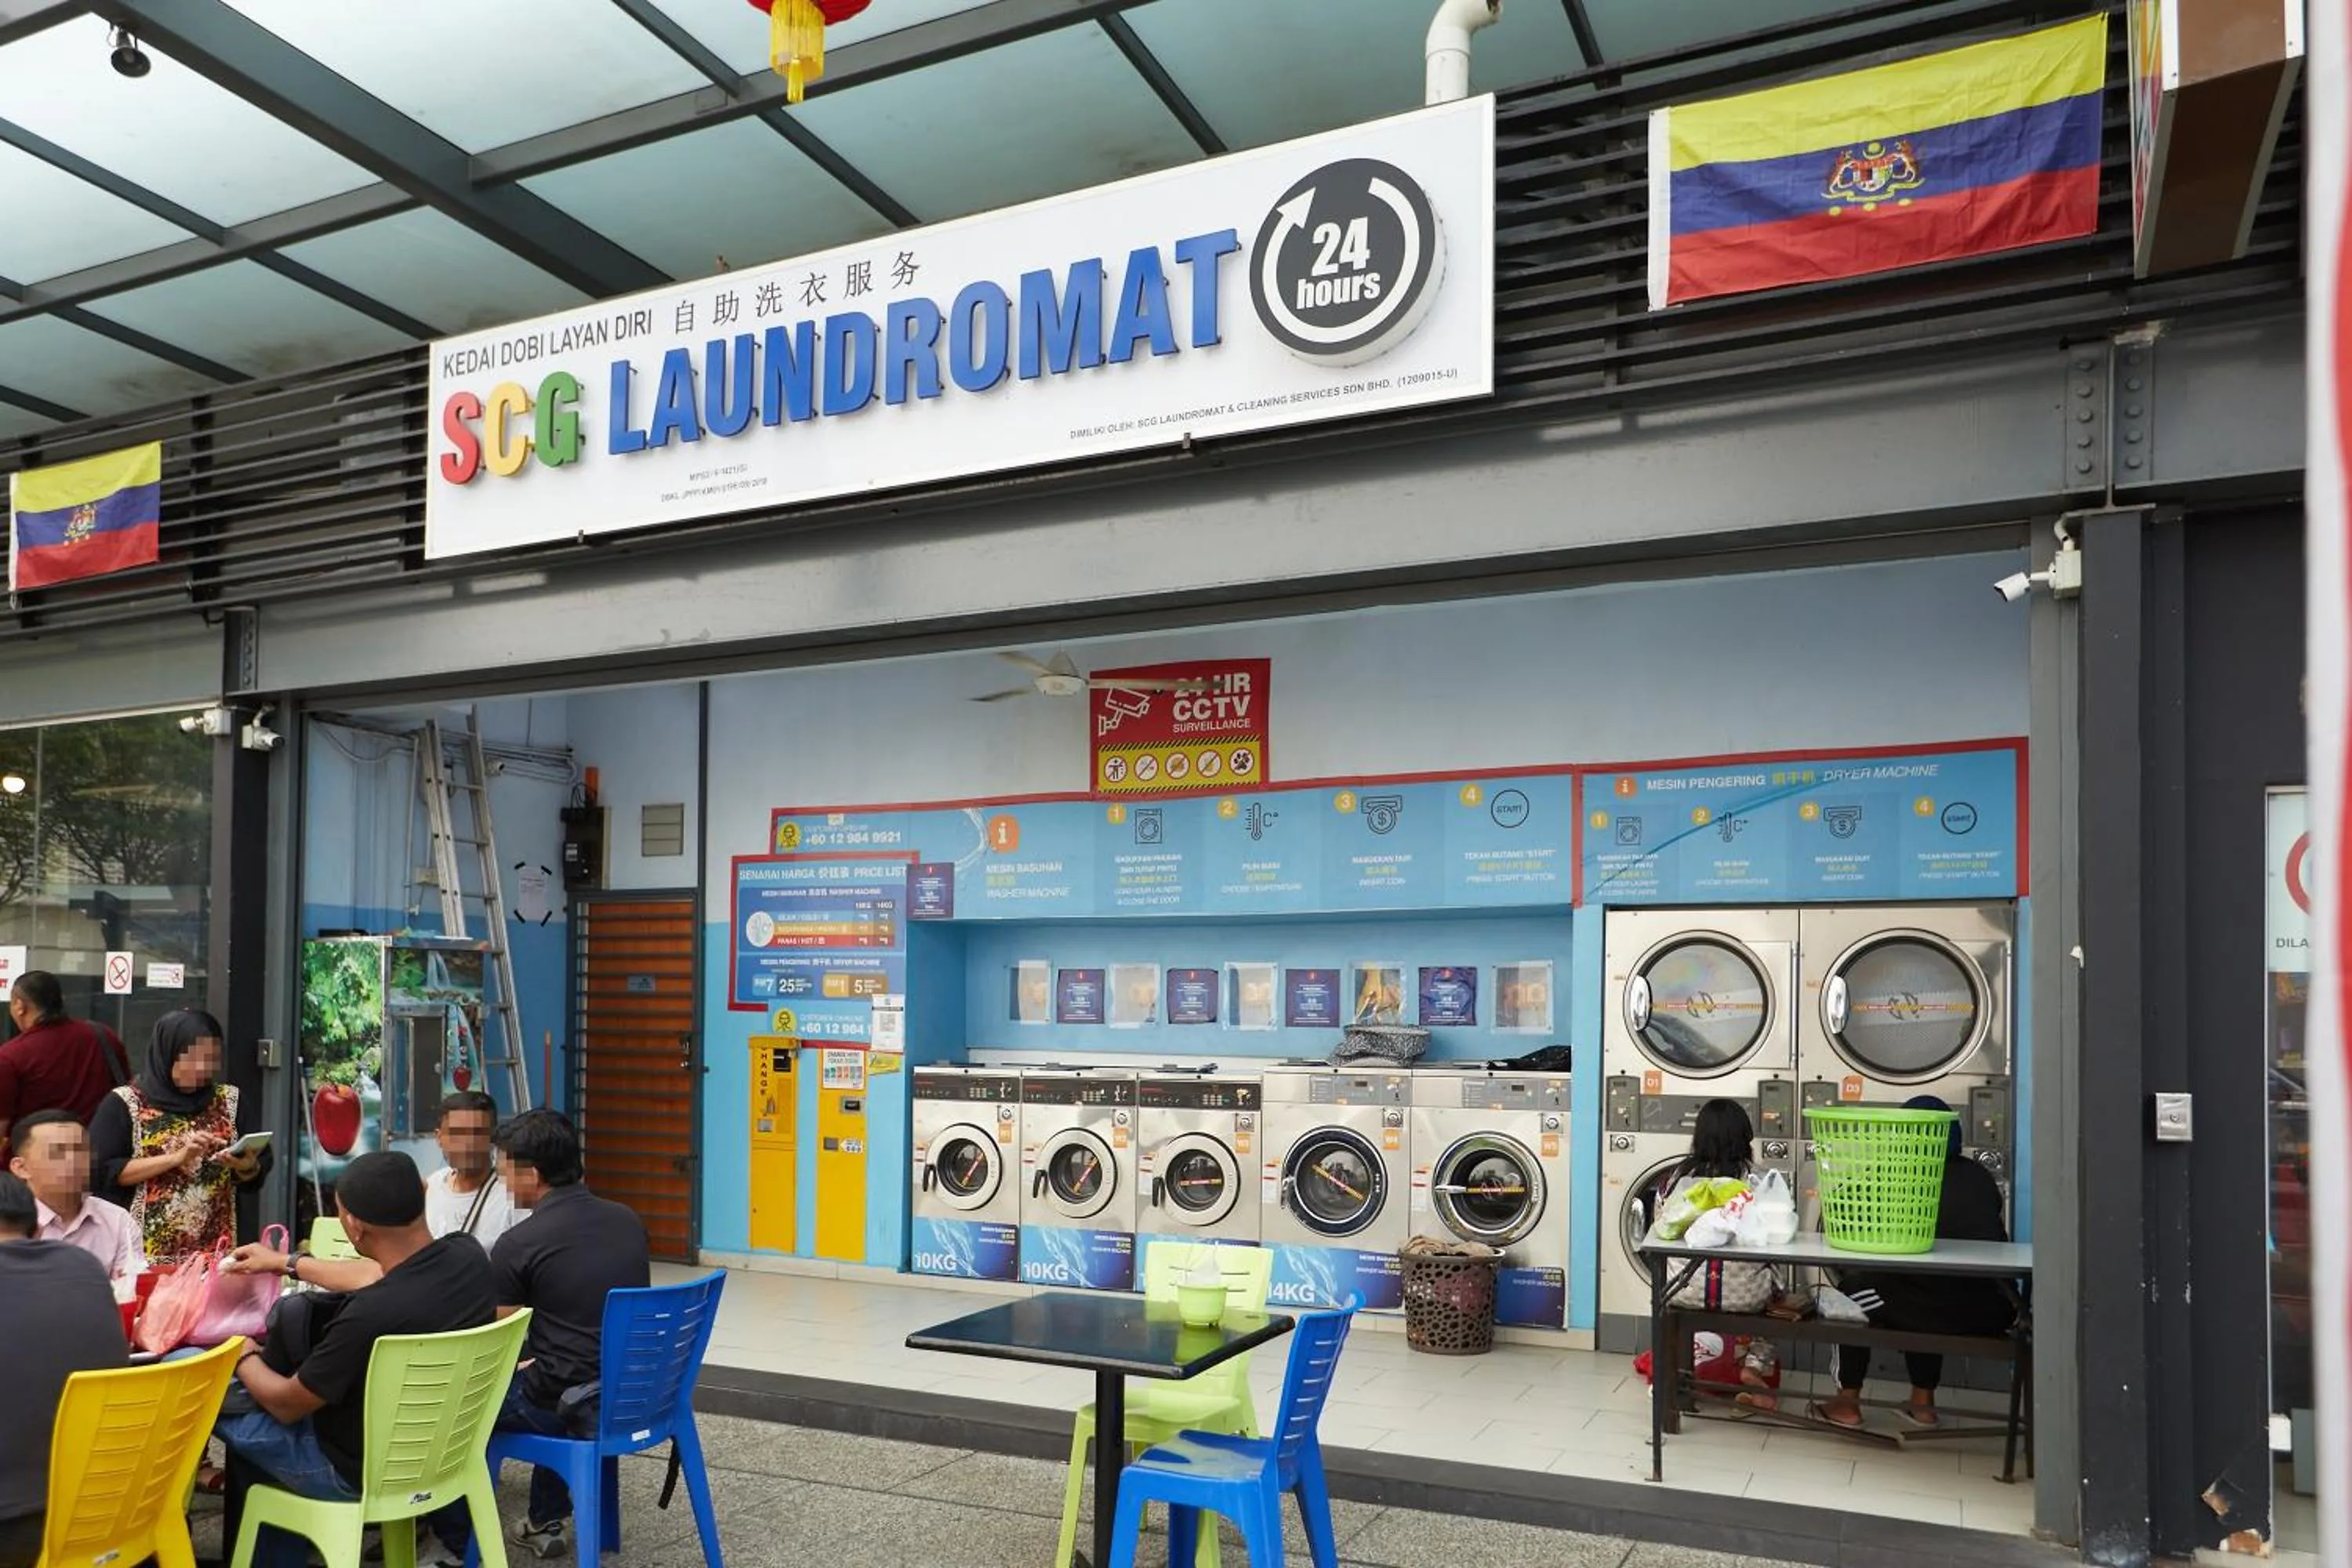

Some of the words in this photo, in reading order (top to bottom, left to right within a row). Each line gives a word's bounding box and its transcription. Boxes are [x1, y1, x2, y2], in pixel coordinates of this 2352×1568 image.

[1311, 217, 1370, 277] 24
[675, 251, 920, 335] 自助洗衣服务
[1296, 270, 1381, 310] hours
[443, 344, 495, 379] KEDAI
[501, 334, 543, 366] DOBI
[550, 318, 608, 354] LAYAN
[615, 309, 652, 340] DIRI
[441, 371, 581, 485] SCG
[608, 227, 1237, 456] LAUNDROMAT
[1160, 405, 1225, 424] LAUNDROMAT
[1228, 405, 1234, 413] &
[1237, 395, 1287, 412] CLEANING
[1290, 387, 1340, 403] SERVICES
[1343, 382, 1365, 394] SDN
[1213, 672, 1251, 695] HR
[1173, 695, 1251, 721] CCTV
[1173, 717, 1251, 734] SURVEILLANCE
[1646, 778, 1686, 790] MESIN
[1690, 774, 1766, 789] PENGERING
[1822, 767, 1871, 782] DRYER
[1873, 764, 1941, 779] MACHINE
[1341, 796, 1351, 808] 3
[1466, 789, 1475, 801] 4
[1496, 804, 1523, 814] START
[1806, 806, 1814, 817] 3
[1919, 801, 1928, 811] 4
[1697, 811, 1705, 821] 2
[829, 833, 844, 844] 12
[739, 869, 780, 880] SENARAI
[782, 869, 815, 879] HARGA
[854, 866, 885, 877] PRICE
[886, 865, 906, 877] LIST
[779, 978, 794, 993] 25
[854, 979, 863, 993] 5
[825, 1022, 840, 1033] 12
[1647, 1077, 1659, 1087] D1
[916, 1252, 956, 1271] 10KG
[1024, 1262, 1069, 1281] 10KG
[1268, 1282, 1315, 1303] 14KG
